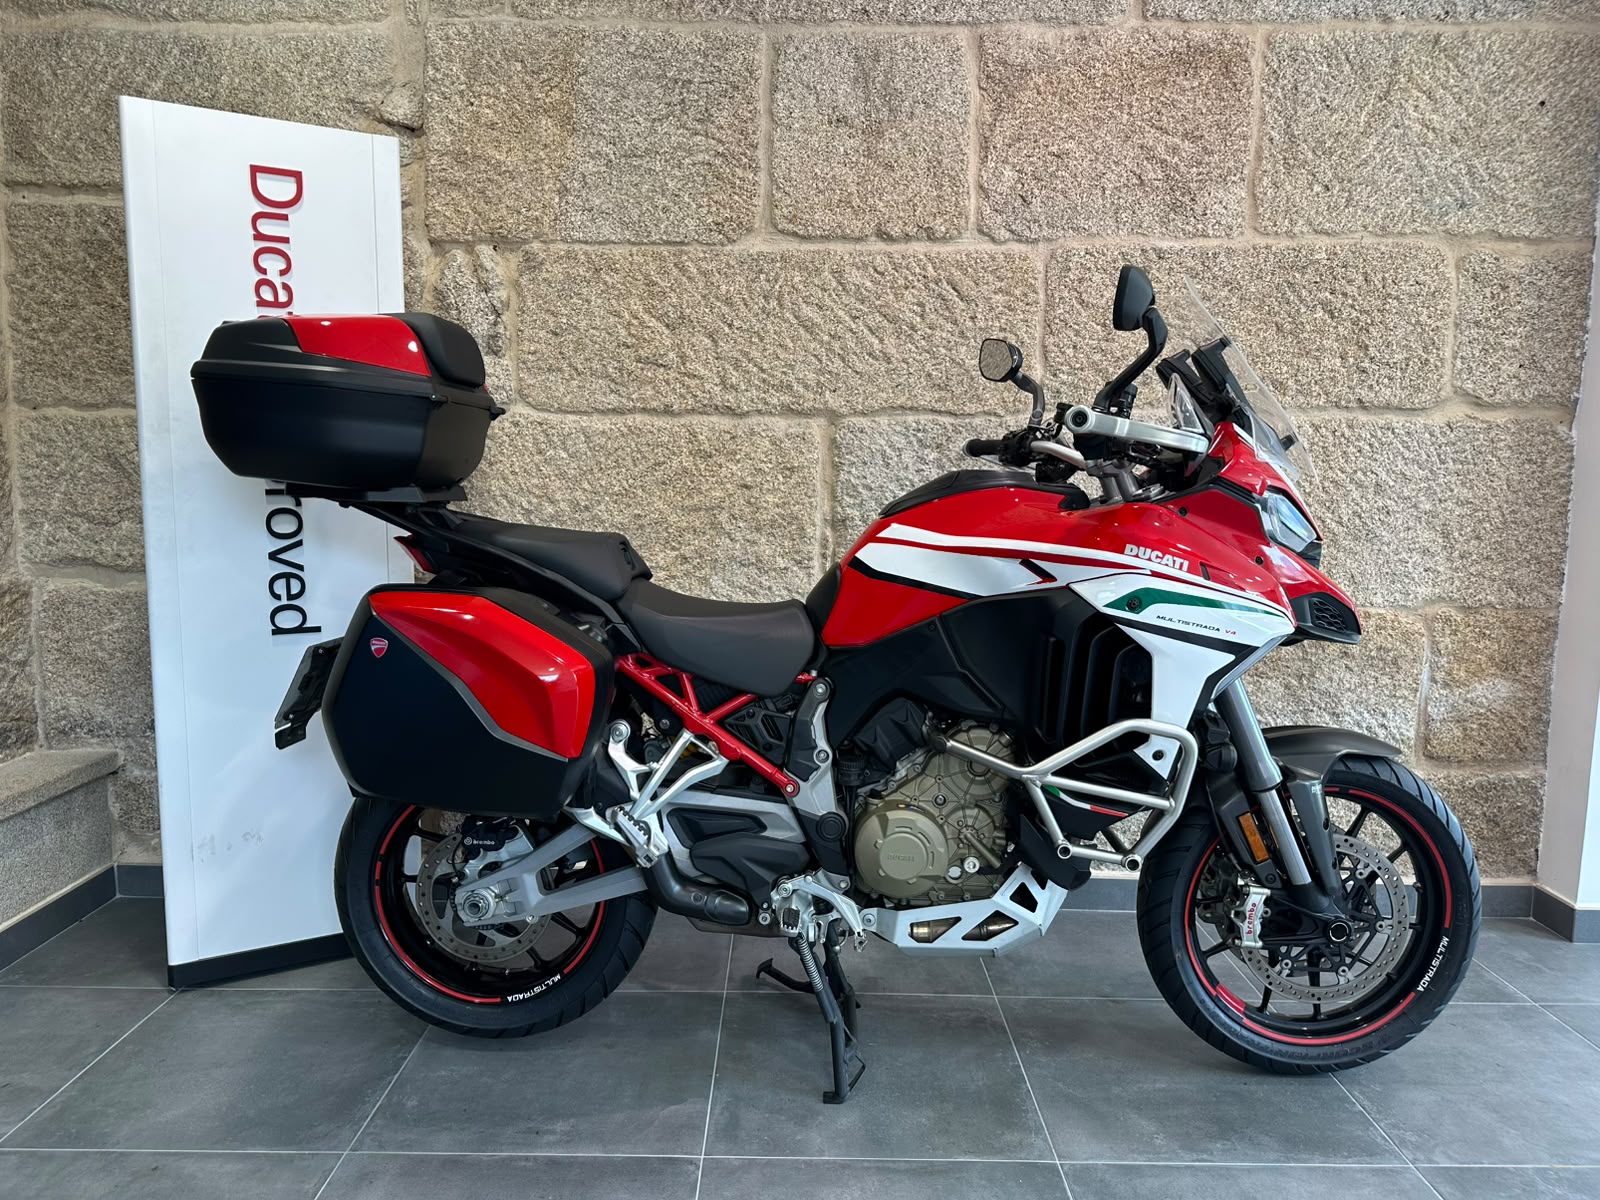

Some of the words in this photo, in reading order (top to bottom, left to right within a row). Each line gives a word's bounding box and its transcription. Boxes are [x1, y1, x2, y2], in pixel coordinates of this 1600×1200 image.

[249, 163, 303, 319] Duca
[265, 480, 322, 636] roved
[1123, 543, 1189, 573] DUCATI
[1155, 614, 1221, 633] MULTISTRADA
[1225, 628, 1237, 636] V4
[472, 838, 496, 846] brembo
[1245, 902, 1257, 935] brembo
[1416, 935, 1450, 992] MULTISTRADA
[506, 973, 561, 1003] MULTISTRADA
